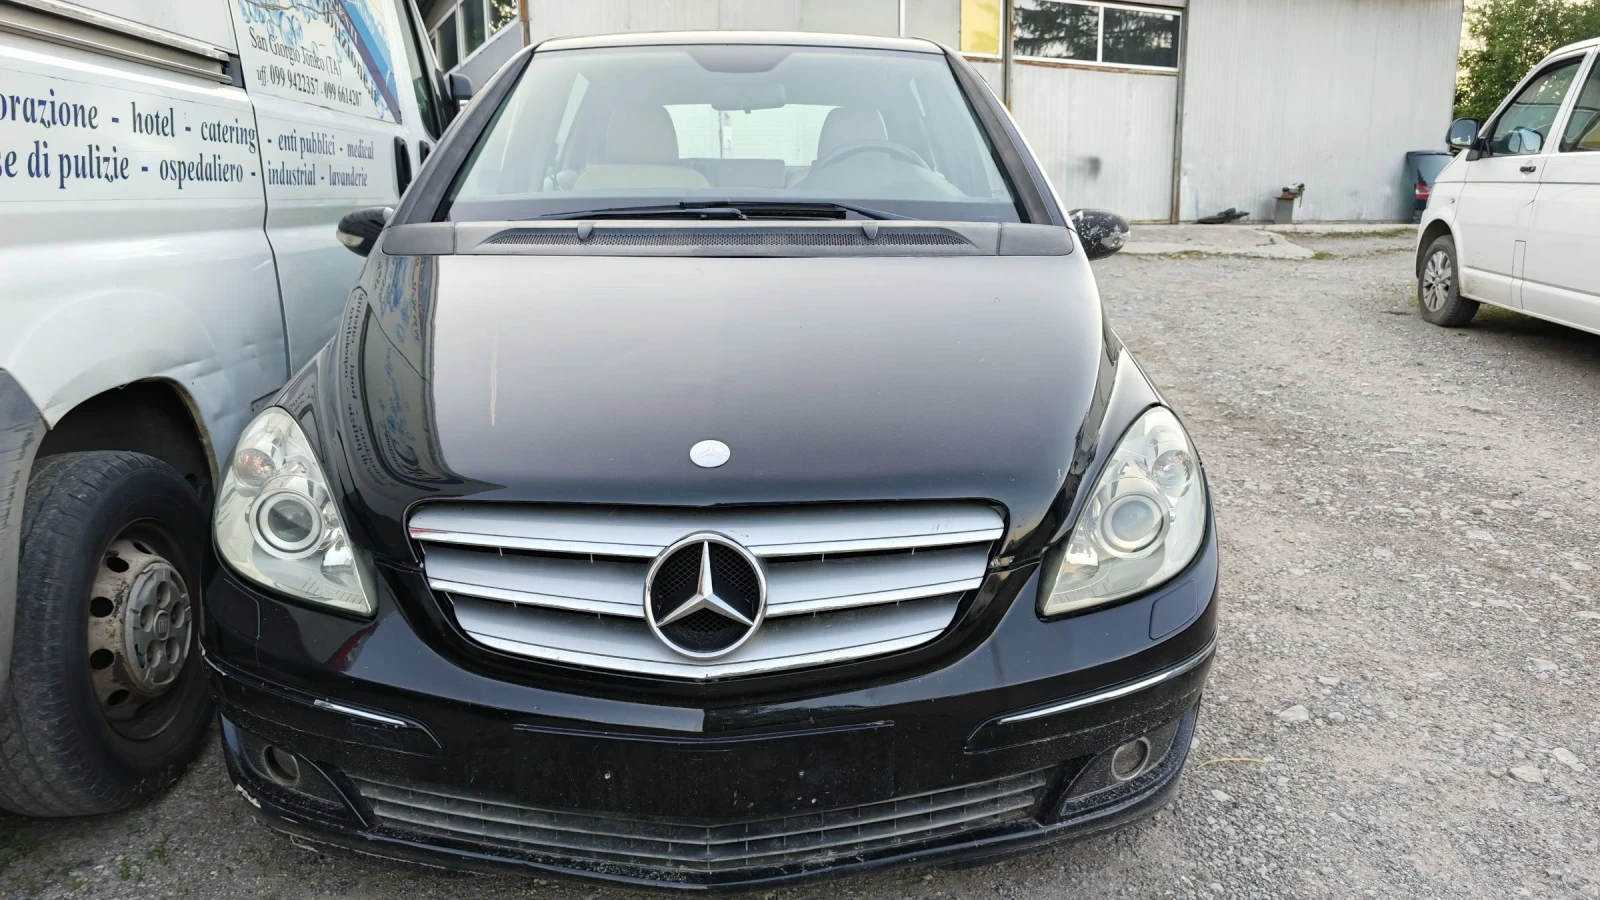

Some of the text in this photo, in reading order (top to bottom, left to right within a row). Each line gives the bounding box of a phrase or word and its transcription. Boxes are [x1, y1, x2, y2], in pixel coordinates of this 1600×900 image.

[249, 26, 269, 52] San
[269, 33, 301, 66] Giorgio
[325, 55, 342, 79] (TA)
[270, 65, 285, 87] 099
[287, 69, 318, 96] 9422357
[323, 81, 336, 101] 099
[131, 101, 176, 137] hotel
[200, 118, 256, 154] catering
[278, 129, 298, 152] enti
[299, 131, 336, 160] pubblici
[346, 138, 374, 160] medical
[0, 150, 19, 178] e
[27, 140, 51, 178] di
[57, 144, 130, 189] pulizie
[159, 153, 244, 190] ospedaliero
[267, 160, 316, 186] industrial
[328, 165, 368, 187] lavanderie
